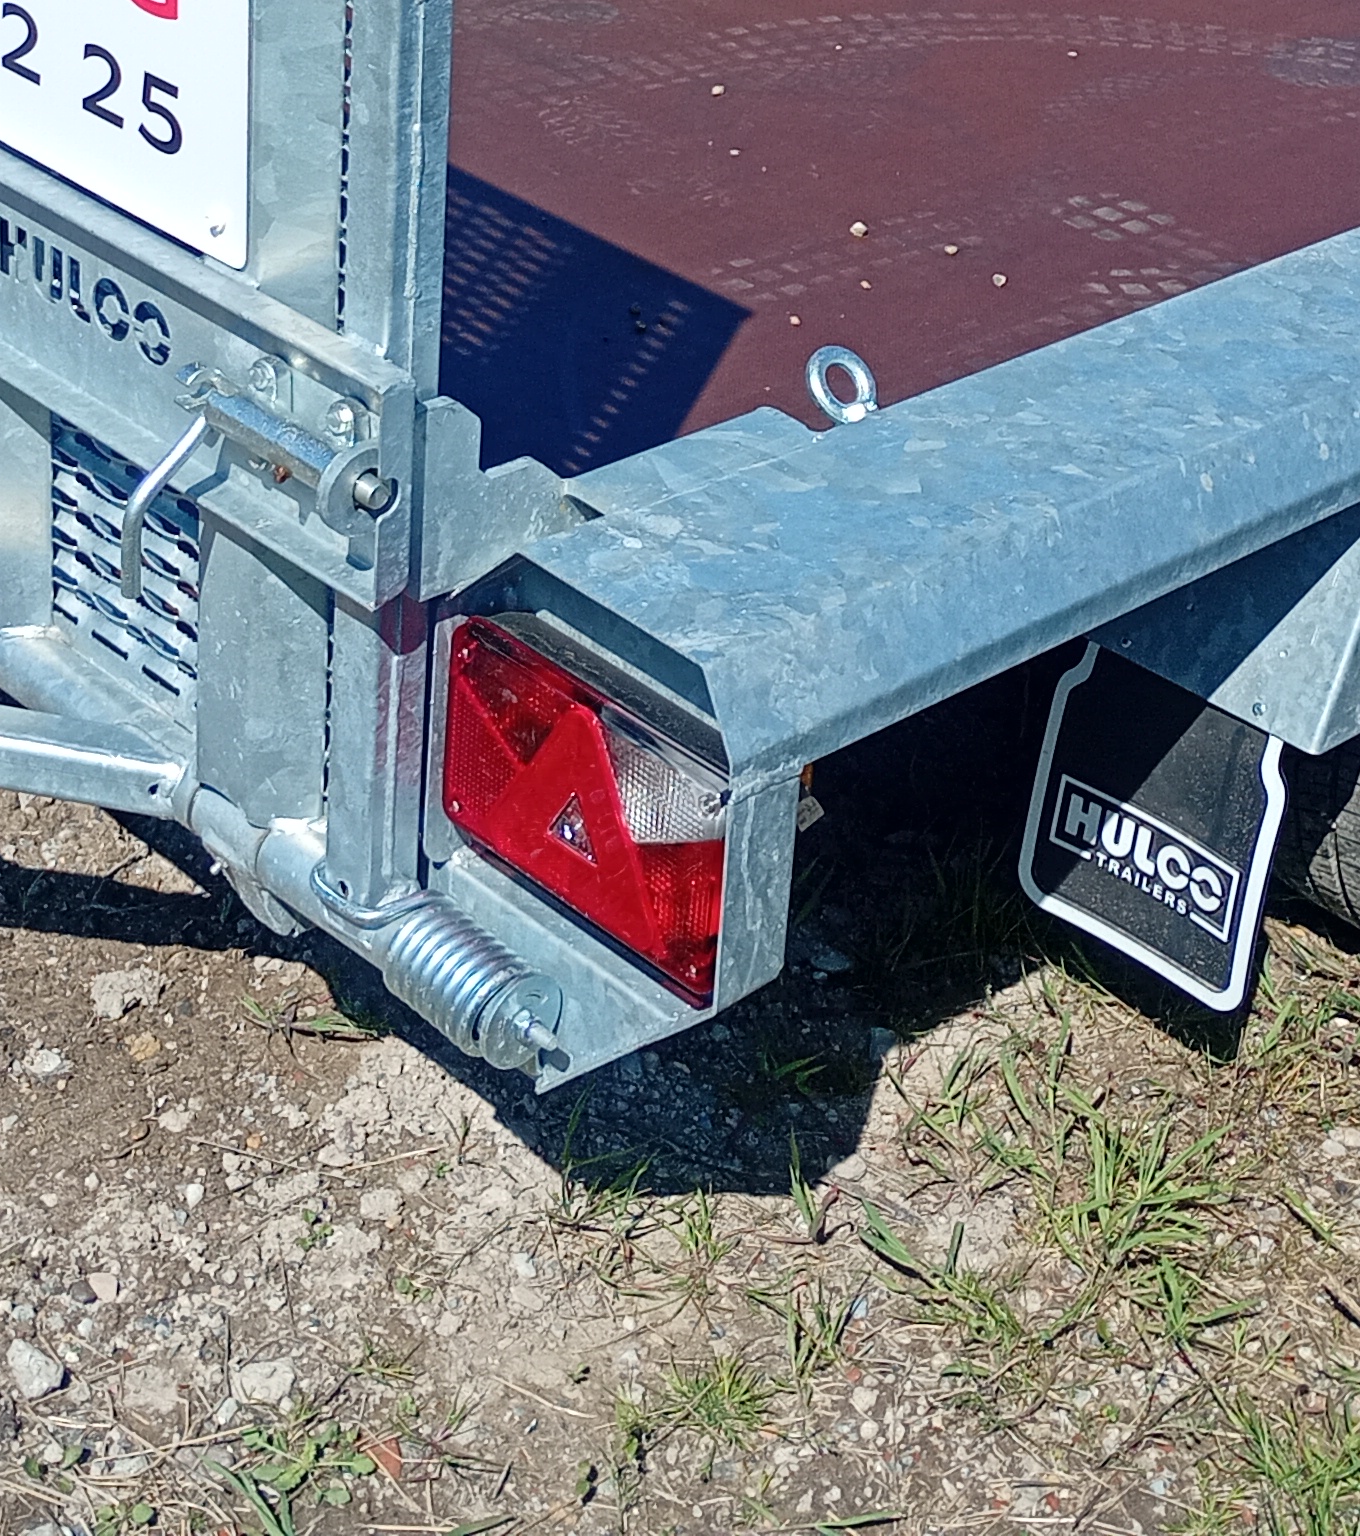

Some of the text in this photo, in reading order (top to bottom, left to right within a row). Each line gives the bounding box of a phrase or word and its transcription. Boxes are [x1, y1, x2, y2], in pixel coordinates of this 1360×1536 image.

[82, 43, 182, 154] 25
[1064, 793, 1223, 912] HULCO
[1096, 851, 1187, 915] TRAILERS
